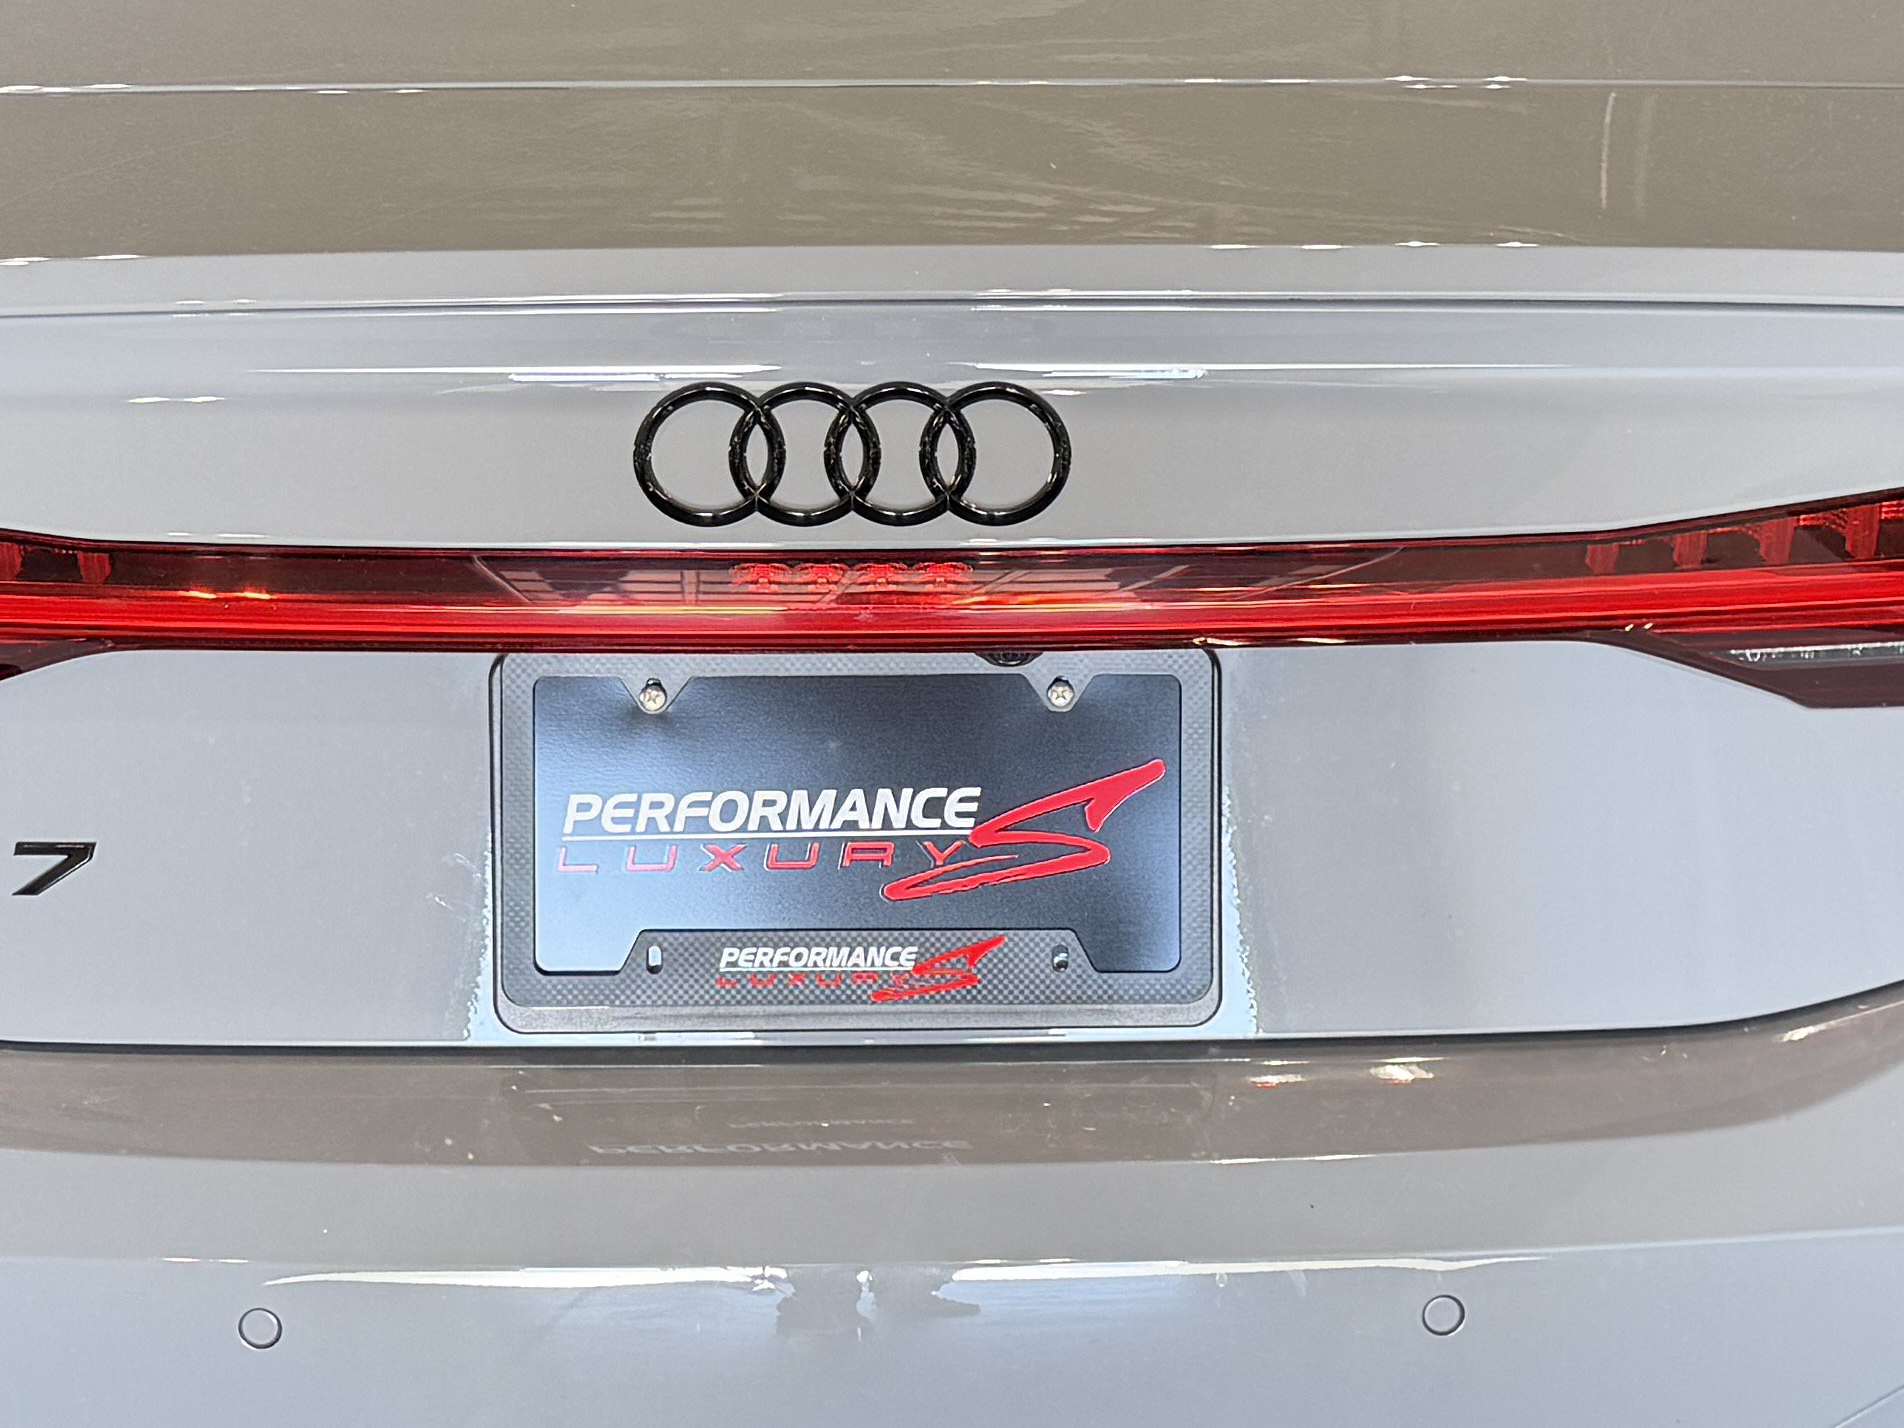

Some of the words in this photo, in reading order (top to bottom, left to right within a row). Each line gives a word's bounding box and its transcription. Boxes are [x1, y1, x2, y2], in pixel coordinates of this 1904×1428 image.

[563, 786, 982, 834] PERFORMANCE
[11, 841, 97, 896] 7
[556, 840, 966, 873] LUXURY
[719, 946, 918, 968] PERFORMANCE
